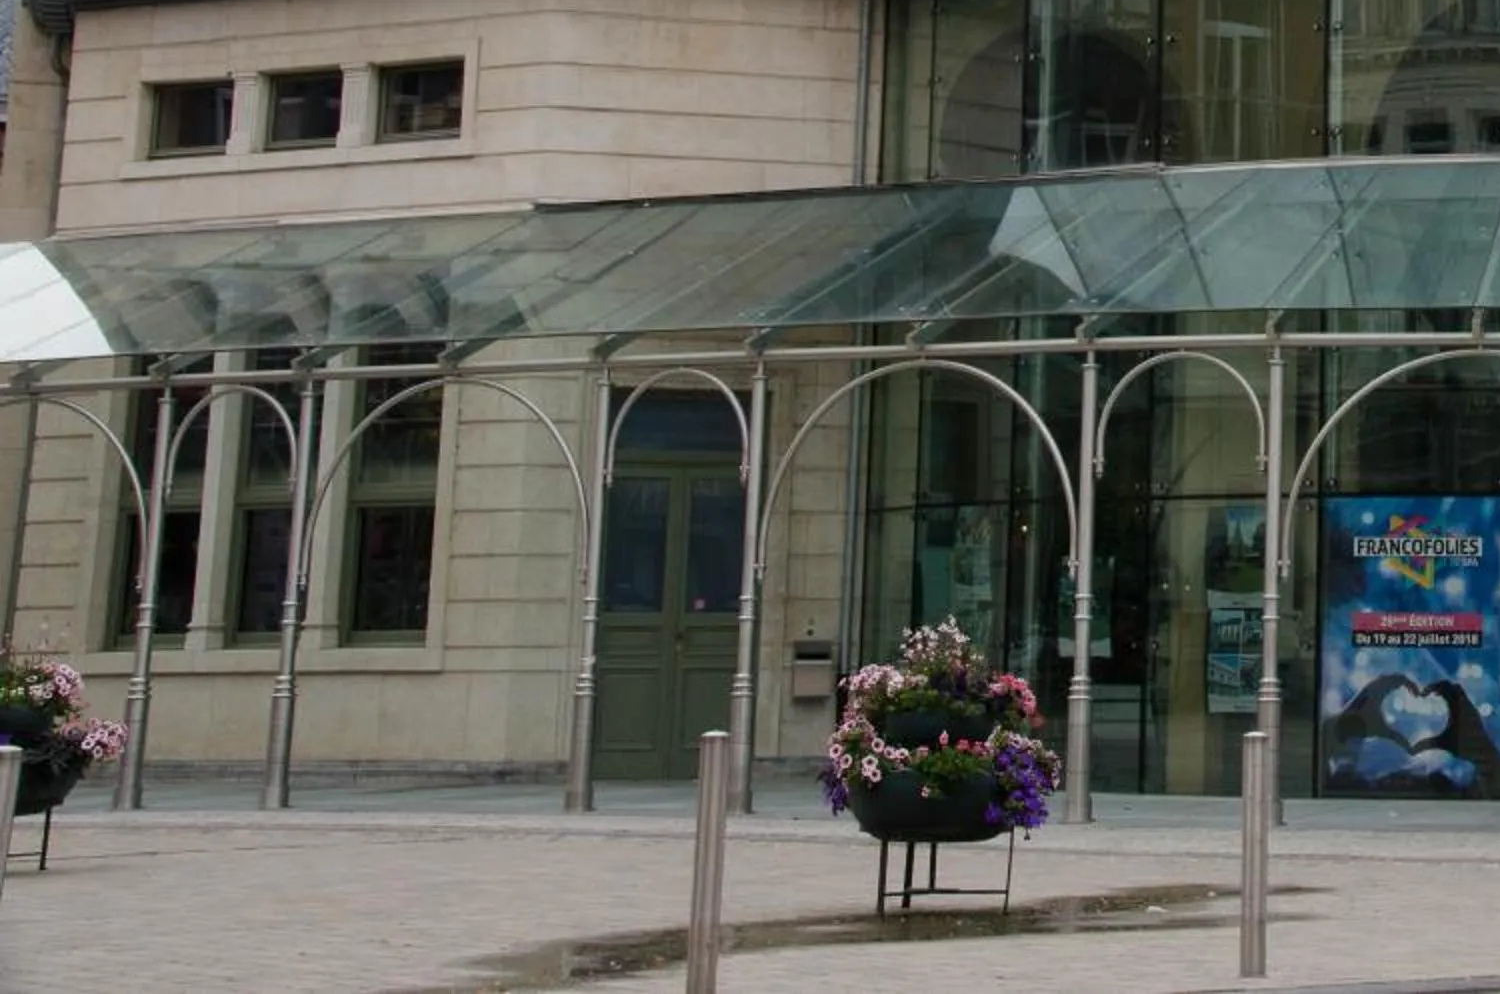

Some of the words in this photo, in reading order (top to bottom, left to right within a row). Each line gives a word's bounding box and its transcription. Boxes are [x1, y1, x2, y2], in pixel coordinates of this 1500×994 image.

[1357, 538, 1478, 555] FRANCOFOLIES
[1355, 633, 1371, 644] Du
[1373, 633, 1386, 644] 19
[1387, 635, 1401, 644] au
[1403, 633, 1417, 645] 22
[1417, 633, 1450, 646] juillet
[1452, 633, 1480, 645] 2018
